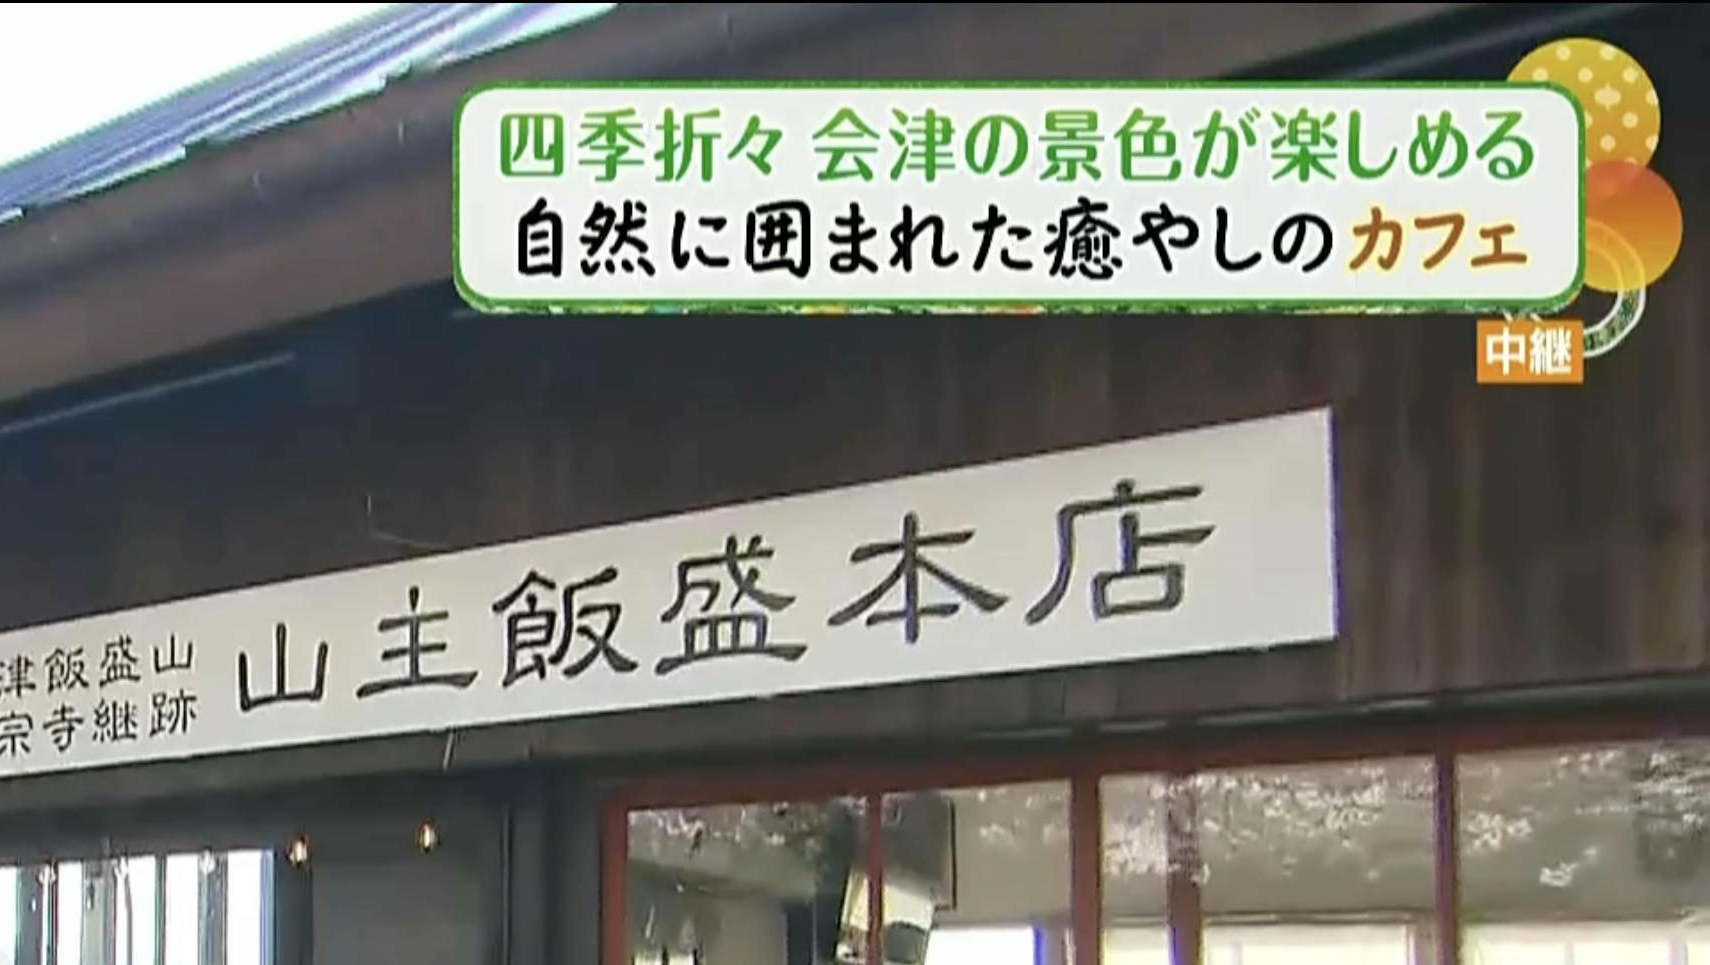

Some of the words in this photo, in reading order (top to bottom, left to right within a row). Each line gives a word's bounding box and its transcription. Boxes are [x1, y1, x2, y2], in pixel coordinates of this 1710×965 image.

[237, 477, 1216, 713] 山主飯盛本店
